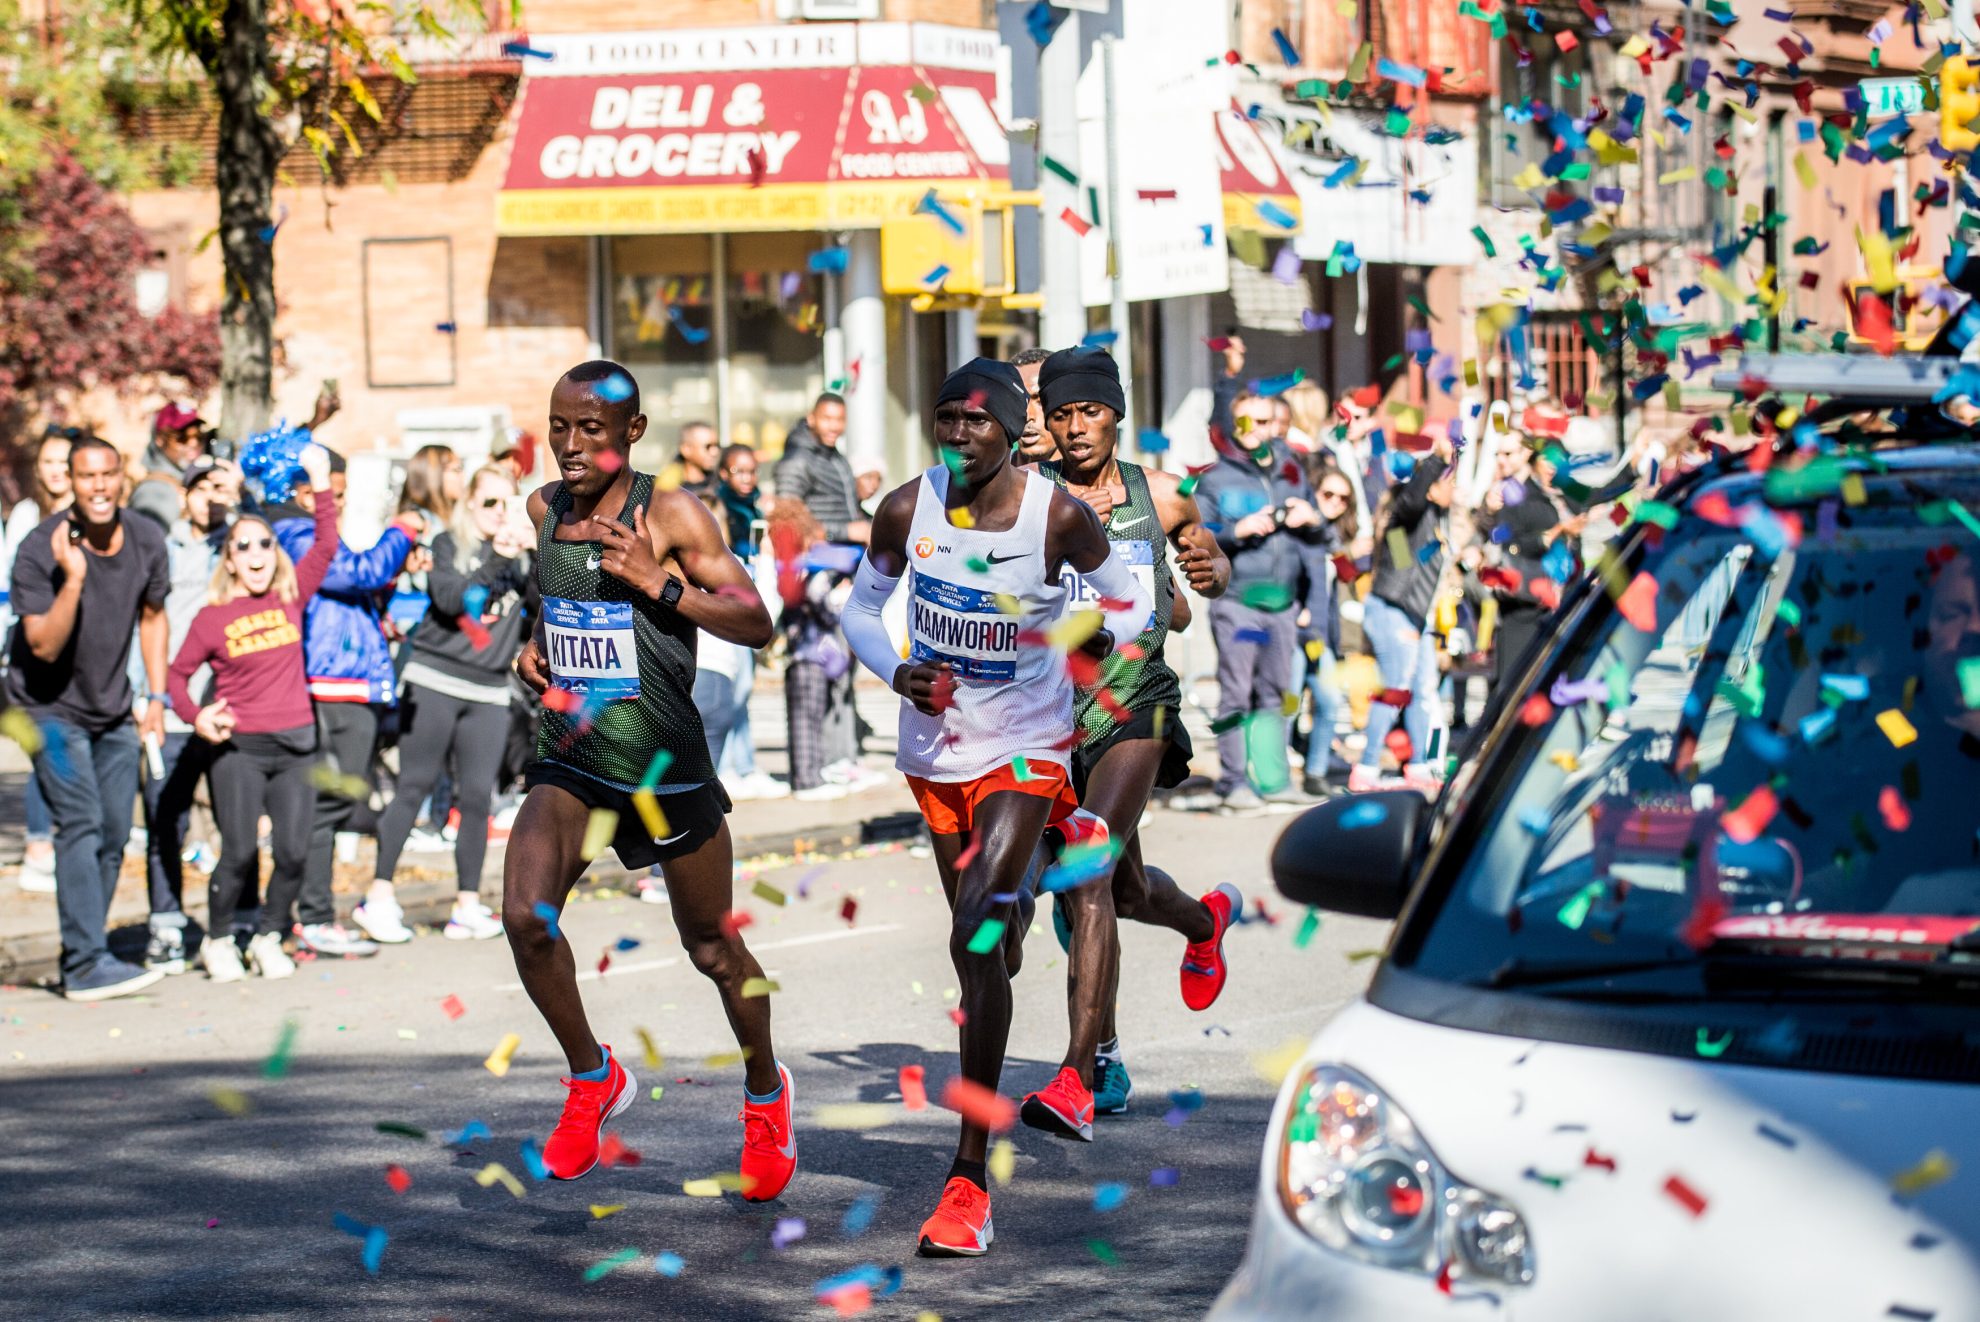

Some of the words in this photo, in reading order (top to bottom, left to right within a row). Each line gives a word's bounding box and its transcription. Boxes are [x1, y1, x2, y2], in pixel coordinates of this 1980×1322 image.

[588, 40, 678, 63] FOOD
[698, 36, 836, 58] CENTER
[590, 83, 715, 130] DELI
[723, 82, 765, 126] &
[539, 130, 801, 179] GROCERY
[840, 153, 895, 178] FOOD
[894, 151, 970, 177] CENTER
[937, 545, 952, 554] NN
[930, 585, 970, 602] CONSULTANCY
[940, 583, 958, 593] TATA
[557, 615, 579, 624] SERVICES
[914, 602, 1019, 652] KAMWOROR
[551, 632, 622, 670] KITATA
